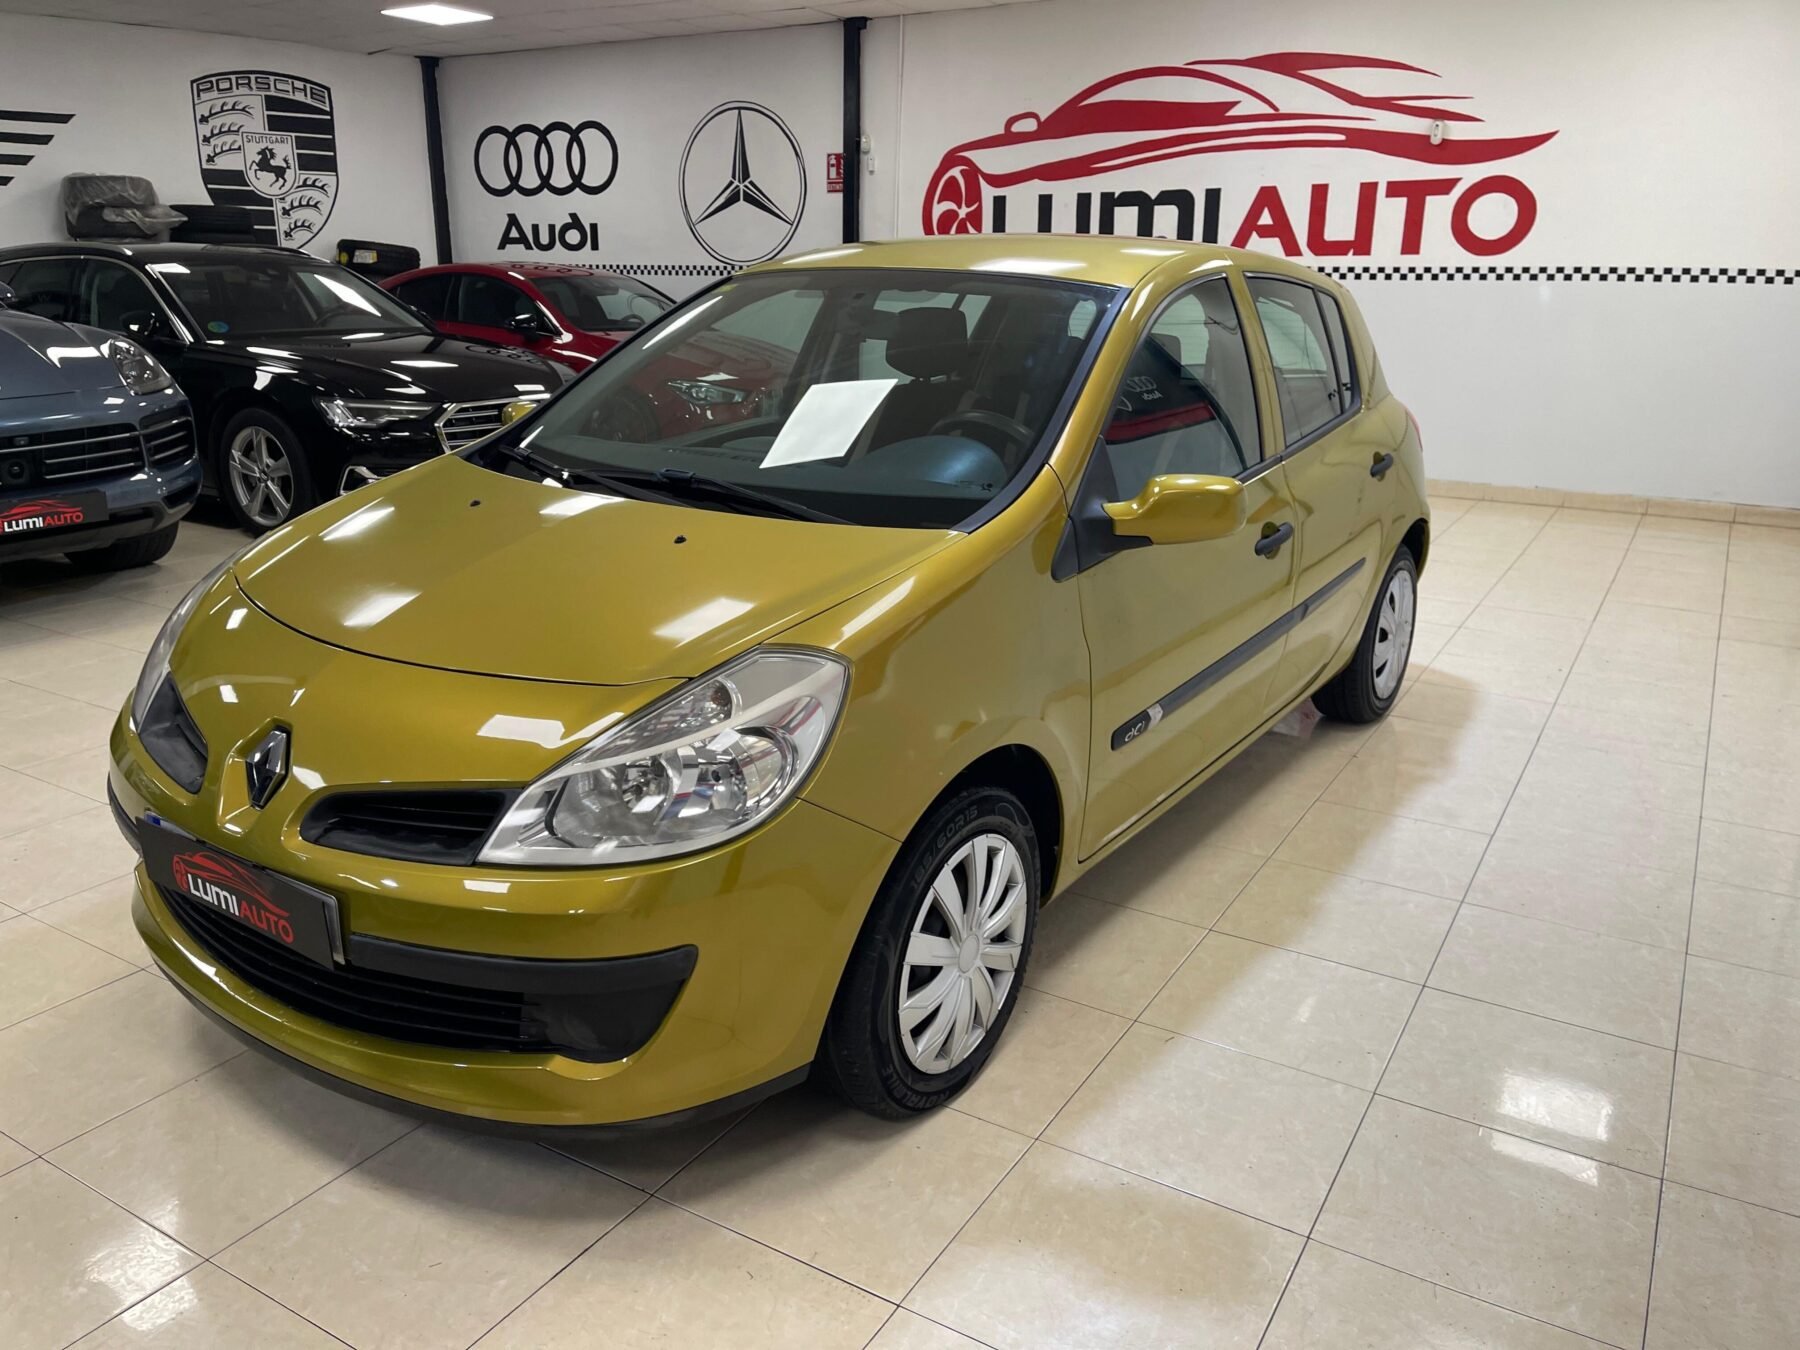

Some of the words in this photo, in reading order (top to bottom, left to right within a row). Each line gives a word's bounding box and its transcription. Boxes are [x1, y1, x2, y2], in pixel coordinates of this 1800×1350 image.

[197, 76, 327, 106] PORSCHE
[245, 134, 289, 145] STUTTGART
[497, 213, 599, 251] Audi
